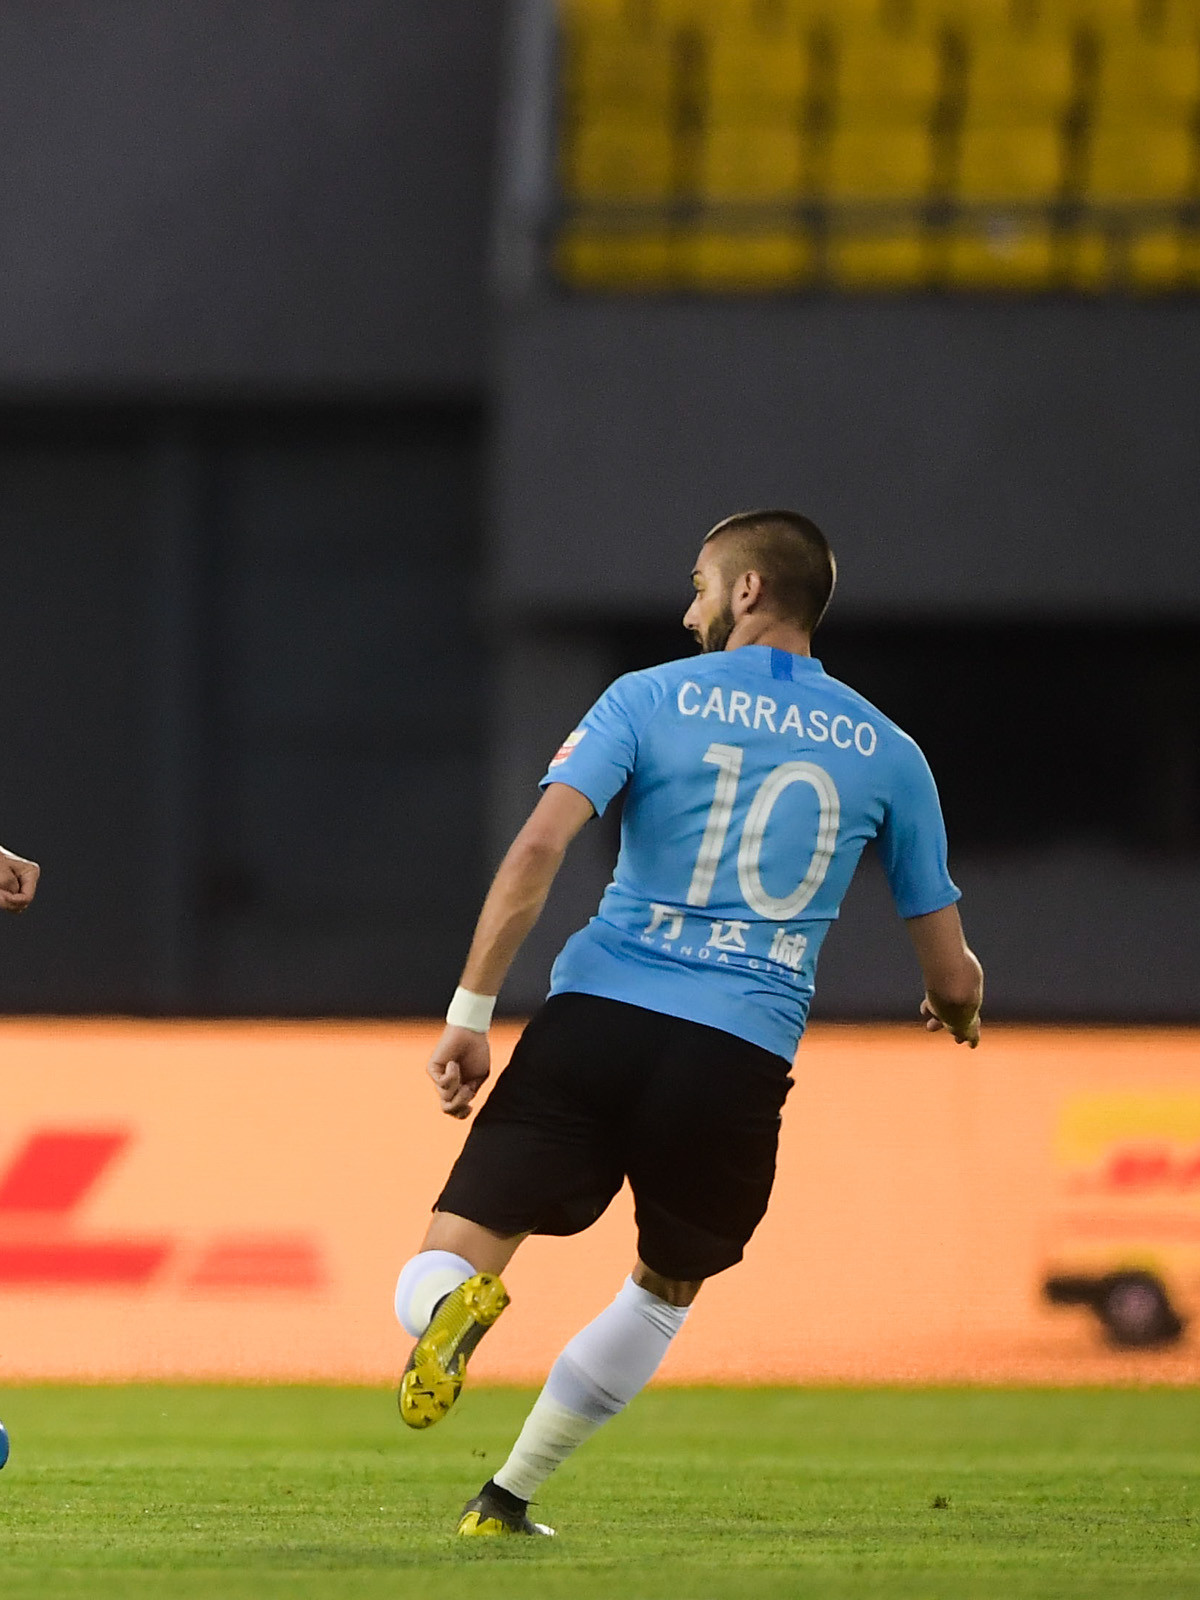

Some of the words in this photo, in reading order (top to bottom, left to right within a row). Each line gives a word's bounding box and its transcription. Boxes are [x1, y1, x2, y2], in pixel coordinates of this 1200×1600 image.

[677, 680, 878, 758] CARRASCO
[687, 742, 841, 921] 10
[643, 902, 808, 972] 万达城
